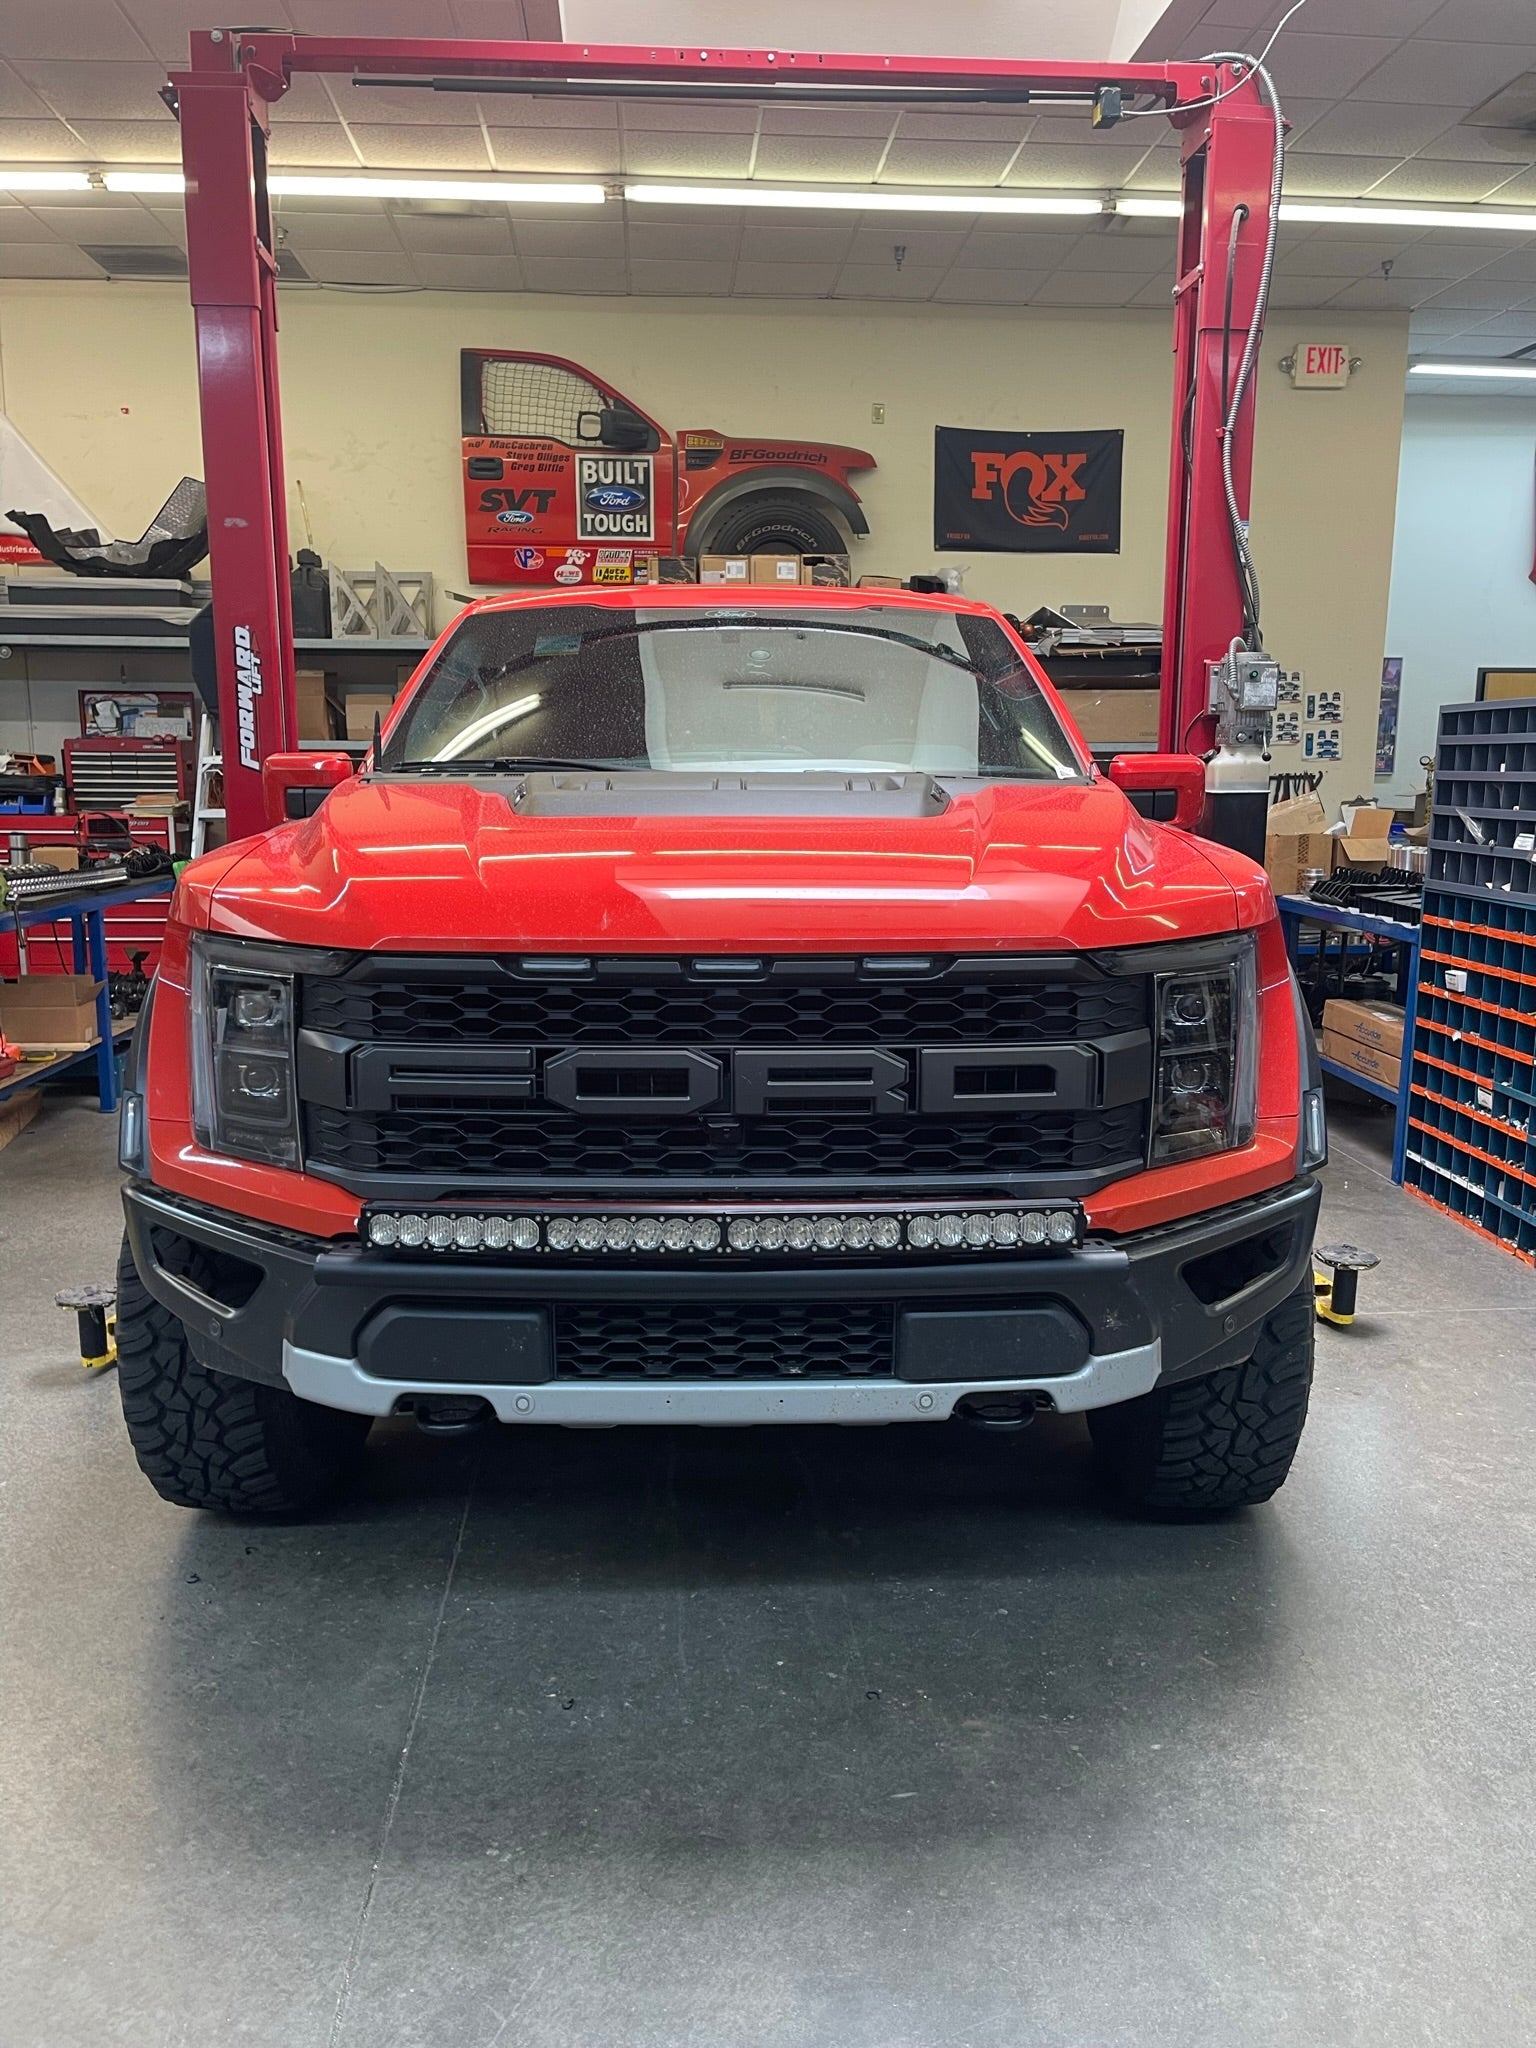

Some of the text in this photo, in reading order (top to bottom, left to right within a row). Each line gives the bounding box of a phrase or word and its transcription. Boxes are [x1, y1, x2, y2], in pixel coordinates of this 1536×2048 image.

[1306, 347, 1343, 374] EXIT
[506, 451, 533, 460] Steve
[511, 461, 565, 473] Greg Biffle
[729, 449, 828, 464] BFGoodrich
[582, 460, 648, 485] BUILT
[971, 451, 1086, 510] FOX
[478, 488, 557, 513] SVT
[600, 491, 631, 506] Ford
[503, 513, 527, 523] Ford
[583, 513, 648, 533] TOUGH
[487, 526, 544, 534] RACING
[736, 524, 819, 551] BFGoodrich
[515, 547, 535, 568] VP
[251, 652, 263, 695] LIFT
[235, 626, 260, 770] FORWARD
[350, 1047, 1102, 1117] FORD
